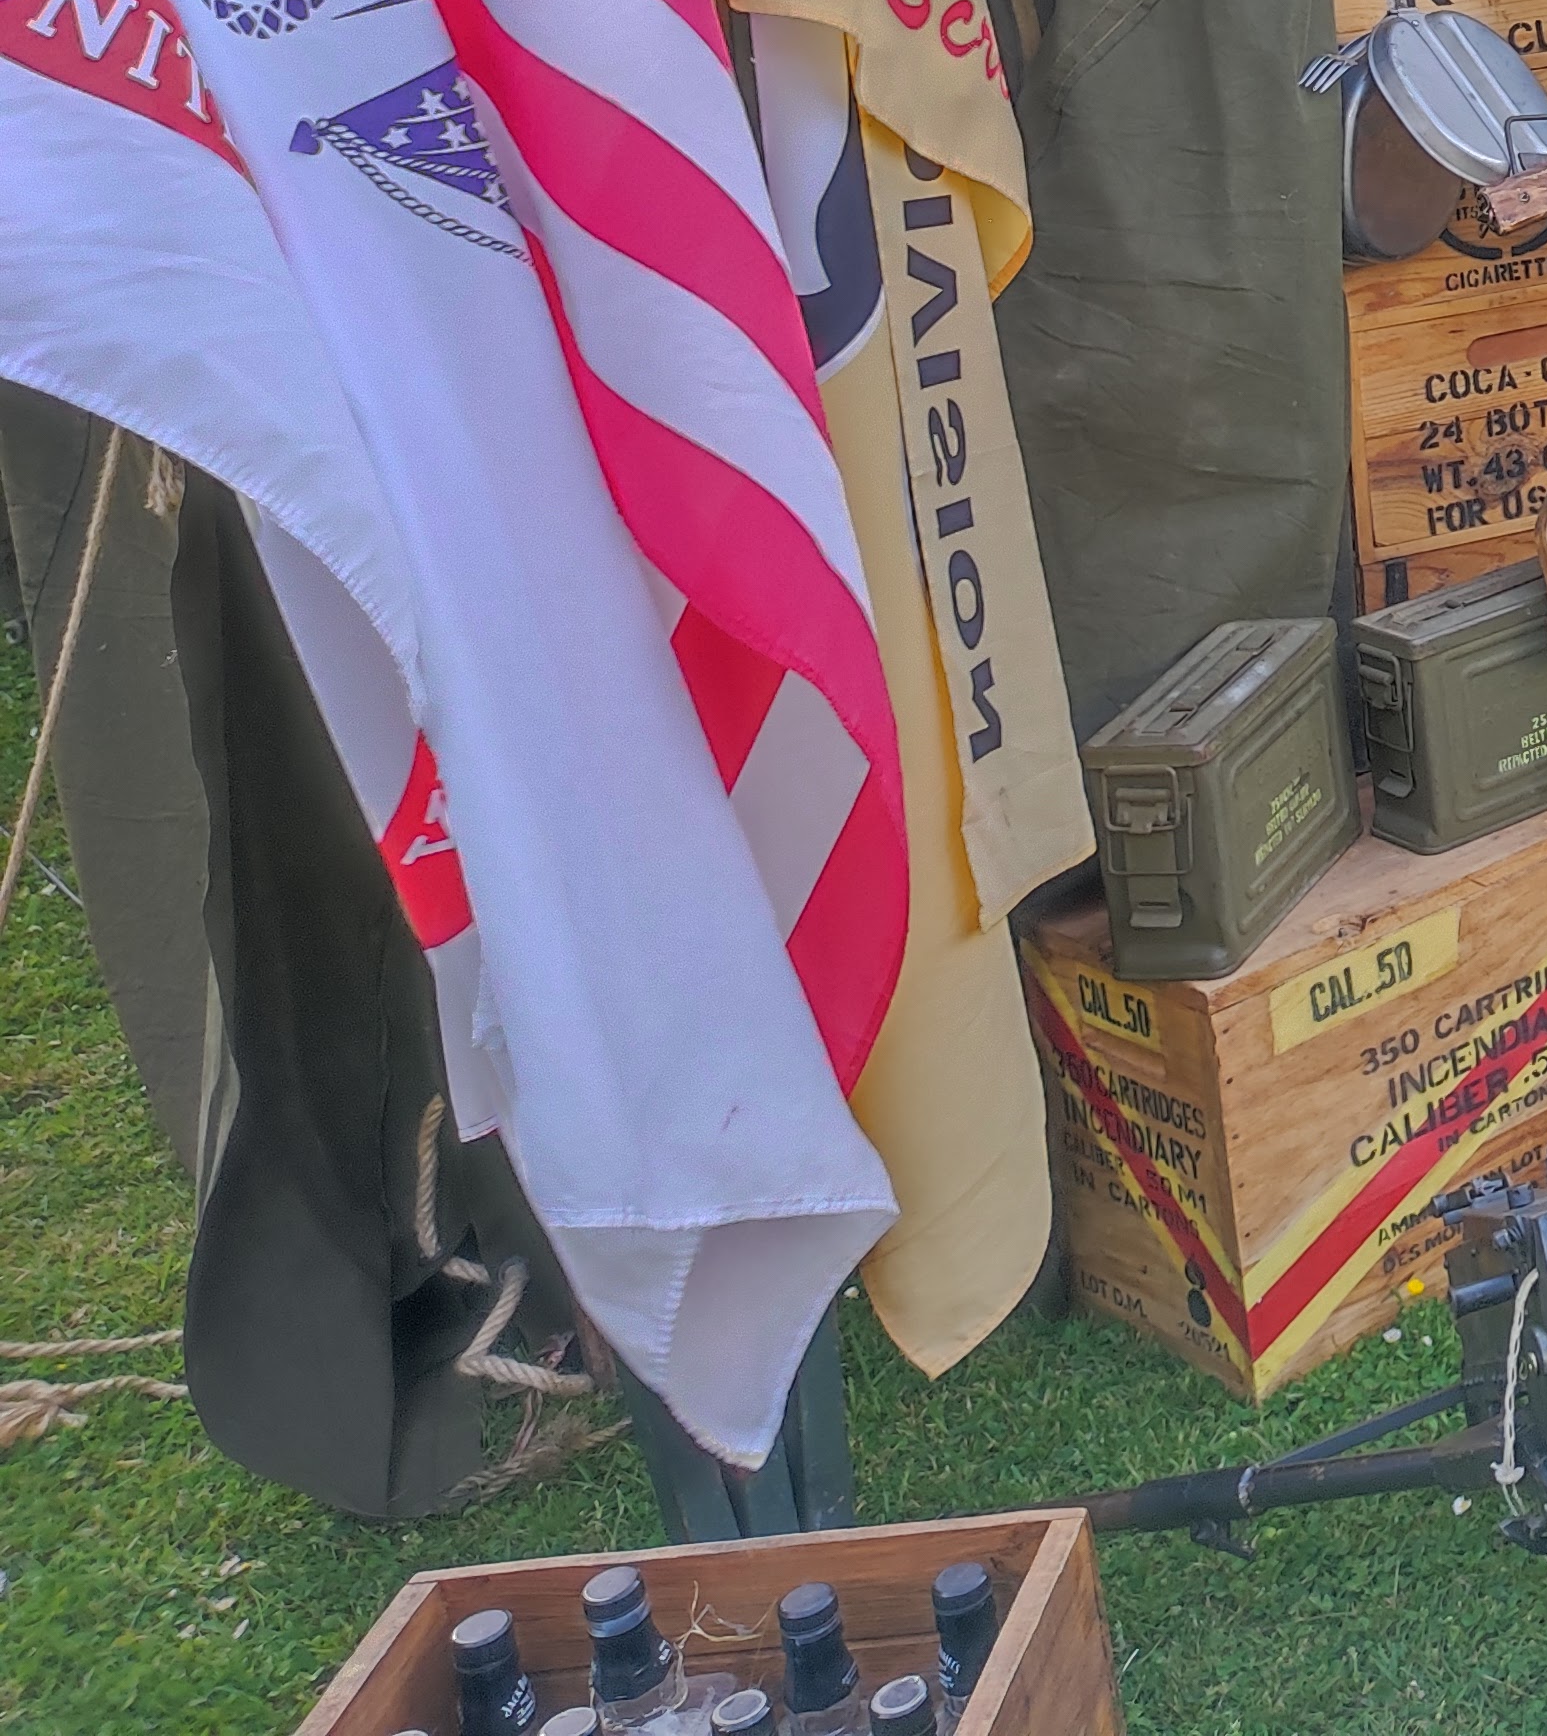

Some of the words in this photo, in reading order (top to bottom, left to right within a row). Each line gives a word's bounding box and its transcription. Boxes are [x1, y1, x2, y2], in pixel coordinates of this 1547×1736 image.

[1419, 416, 1463, 451] 24
[1427, 497, 1488, 536] FOR
[1360, 1028, 1420, 1077] 350
[1094, 1063, 1207, 1141] CARTRIDGES
[1349, 1067, 1509, 1169] CALIBER
[1062, 1089, 1203, 1182] INCENDIARY
[1437, 1131, 1460, 1153] IN
[1510, 1144, 1543, 1173] LOT
[1064, 1132, 1125, 1176] CALIBER
[1178, 1184, 1208, 1215] M1
[1109, 1180, 1200, 1241] CARTONS
[1080, 1269, 1108, 1303] LOT
